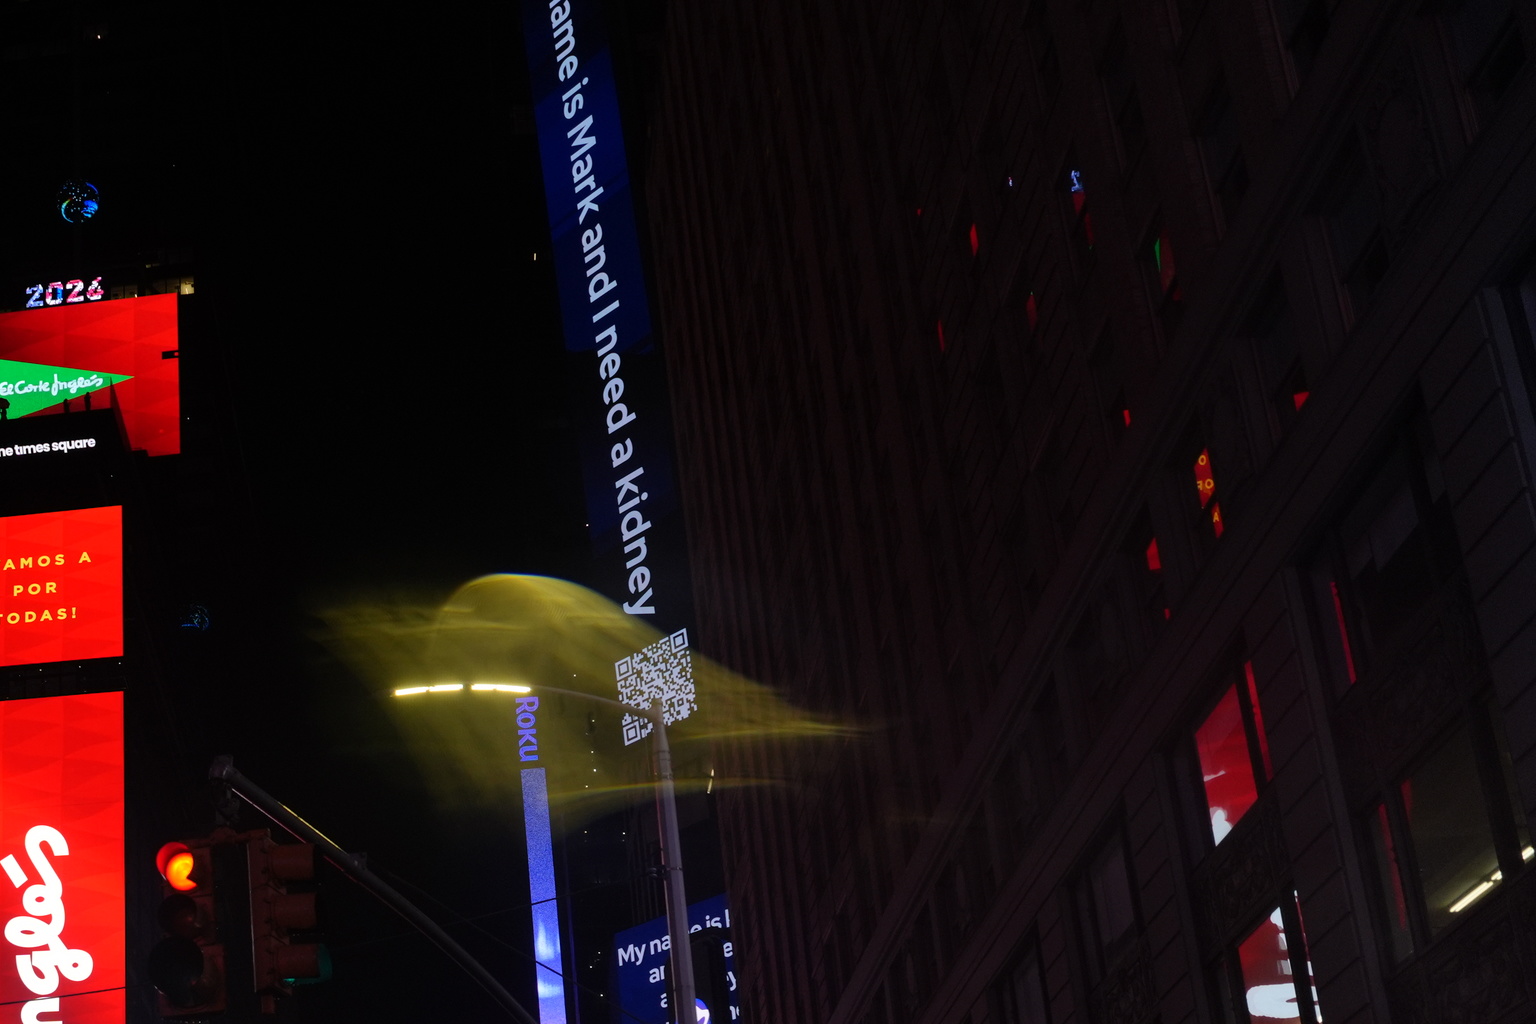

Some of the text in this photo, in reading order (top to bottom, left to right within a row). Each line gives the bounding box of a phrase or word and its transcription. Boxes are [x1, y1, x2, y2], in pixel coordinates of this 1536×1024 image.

[562, 76, 589, 120] is
[567, 114, 604, 226] Mark
[581, 223, 618, 304] and
[25, 276, 105, 309] 2026
[592, 299, 620, 324] I
[14, 379, 51, 395] Corte
[595, 324, 637, 435] need
[14, 441, 50, 456] times
[51, 438, 96, 453] square
[610, 437, 634, 469] a
[78, 551, 92, 564] A
[615, 466, 656, 616] kidney
[13, 582, 57, 597] POR
[617, 943, 647, 967] My
[650, 924, 703, 956] nae
